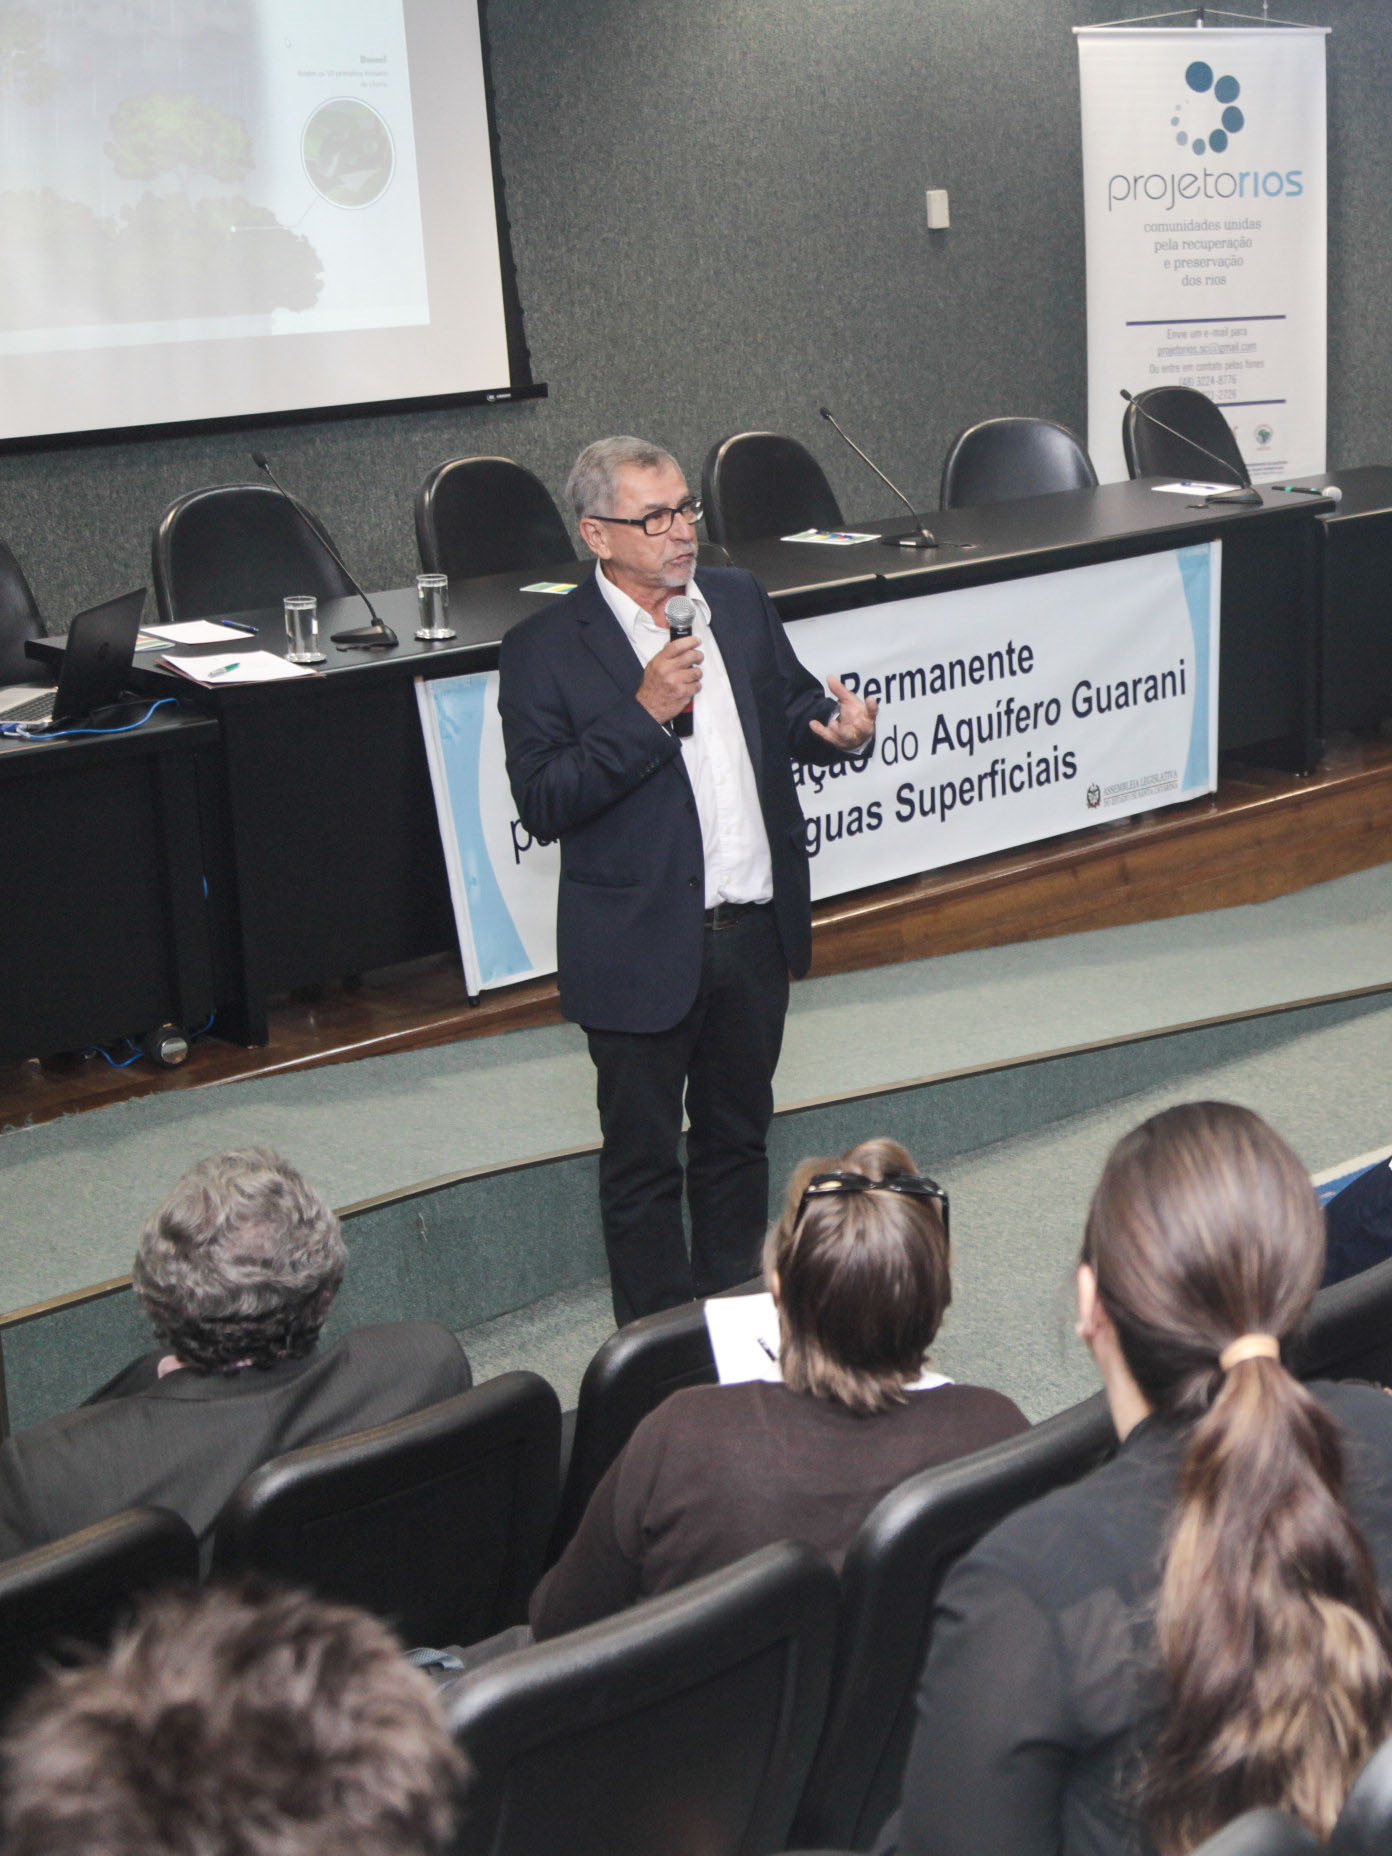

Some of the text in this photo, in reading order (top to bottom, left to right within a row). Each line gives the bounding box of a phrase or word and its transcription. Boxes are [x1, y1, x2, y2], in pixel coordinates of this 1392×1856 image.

[1108, 167, 1304, 212] projetorios
[1144, 218, 1262, 233] comunidades unidas
[1154, 236, 1253, 253] pela recuperação
[1163, 255, 1244, 271] e preservação
[1181, 273, 1227, 286] dos rios
[1190, 330, 1202, 339] um
[1231, 327, 1247, 338] para
[840, 640, 1034, 705] Permanente
[881, 725, 919, 766] do
[931, 697, 1061, 757] Aquífero
[1071, 659, 1187, 718] Guarani
[804, 745, 1078, 858] guas Superficiais
